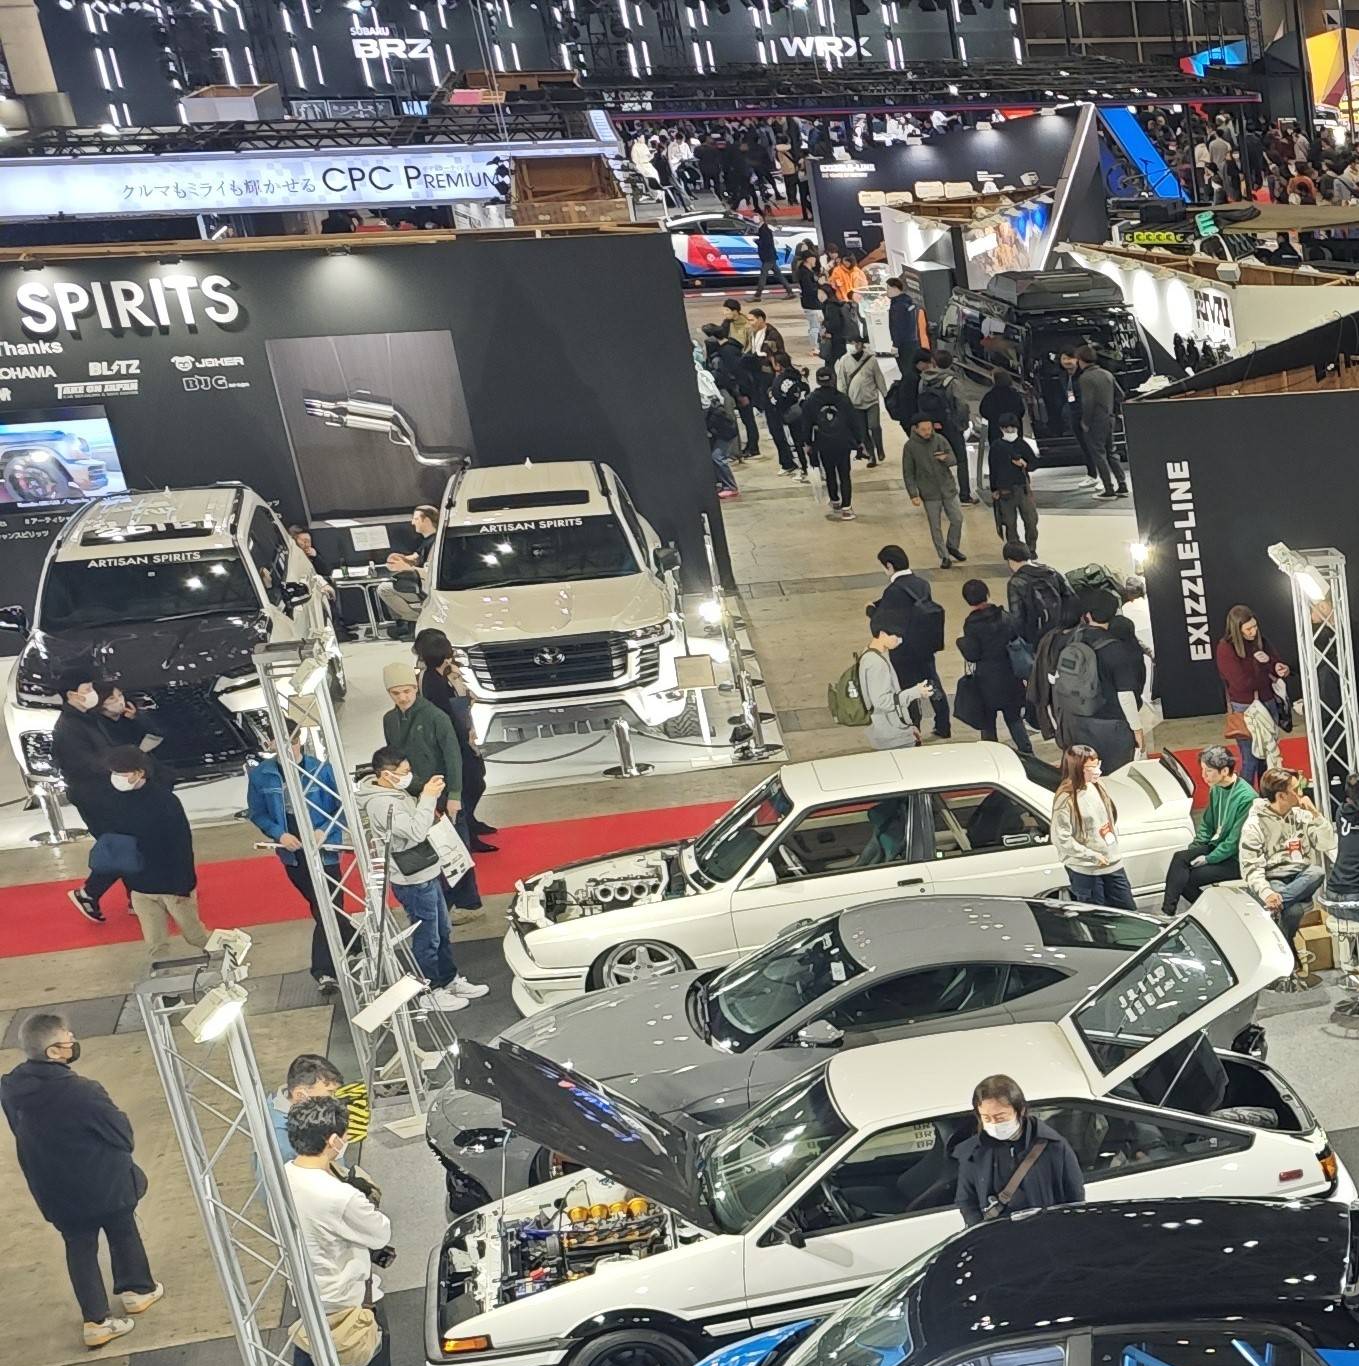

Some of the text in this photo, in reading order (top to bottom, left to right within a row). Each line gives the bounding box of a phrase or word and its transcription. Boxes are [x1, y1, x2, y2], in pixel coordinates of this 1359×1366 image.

[352, 38, 432, 59] BRZ
[780, 36, 873, 57] WRX
[322, 166, 394, 192] CPC
[16, 274, 239, 333] SPIRITS
[89, 359, 141, 377] BLITZ
[195, 356, 245, 369] JOKER
[480, 518, 583, 534] ARTISAN SPIRITS
[87, 552, 201, 569] ARTISAN SPIRITS
[1166, 461, 1213, 661] EXIZZLE-LINE
